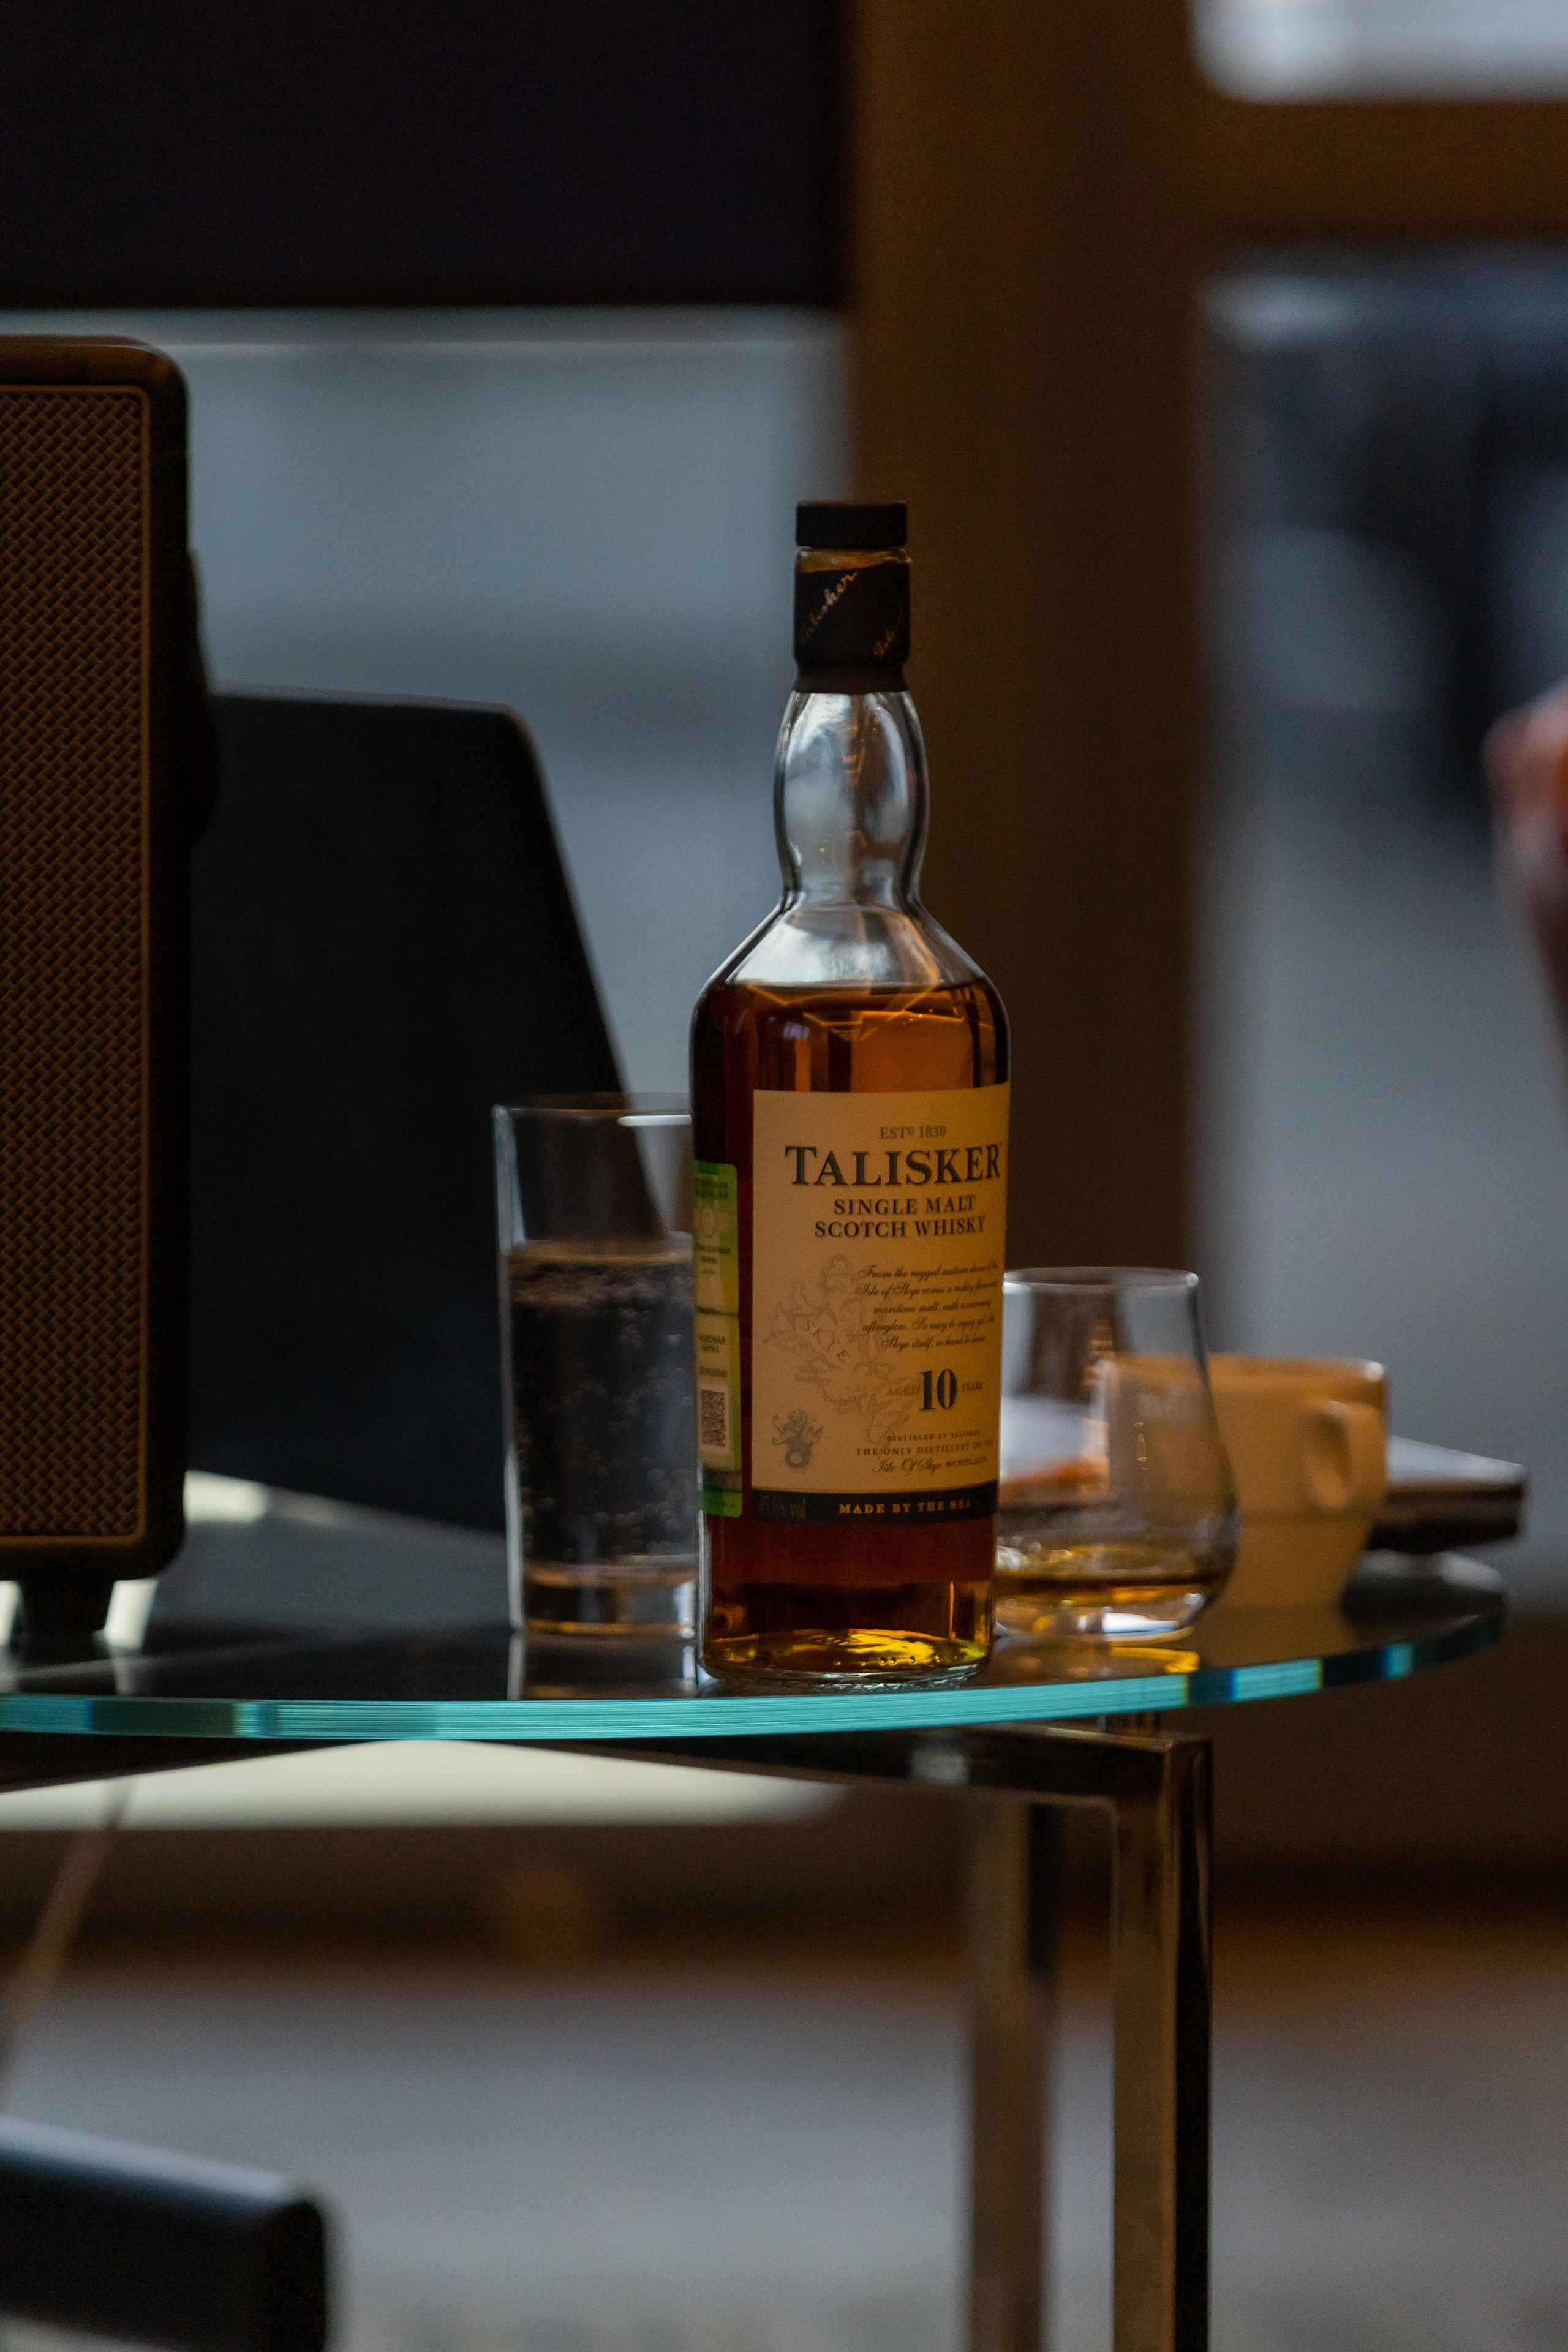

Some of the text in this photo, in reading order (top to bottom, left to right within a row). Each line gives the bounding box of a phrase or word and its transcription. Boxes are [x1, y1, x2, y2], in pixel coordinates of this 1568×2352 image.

[919, 1125, 947, 1139] 1830
[785, 1143, 1002, 1186] TALISKER
[834, 1194, 976, 1216] SINGLE MALT
[815, 1215, 987, 1238] SCOTCH WHISKY
[858, 1264, 891, 1279] From
[894, 1265, 908, 1278] the
[910, 1264, 942, 1283] rugged
[855, 1282, 878, 1297] Isle
[881, 1283, 894, 1300] of
[892, 1281, 920, 1300] Skye
[873, 1303, 916, 1314] maritime
[919, 1299, 941, 1313] malt,
[862, 1318, 910, 1336] afterglow.
[912, 1316, 929, 1330] So
[949, 1318, 957, 1328] to
[881, 1335, 910, 1354] Skye
[886, 1368, 983, 1411] AGED 10 YEARS
[886, 1434, 935, 1442] DISTILLED
[883, 1447, 911, 1455] ONLY
[917, 1444, 969, 1454] DISTILLERY
[872, 1458, 895, 1472] Isle
[918, 1457, 942, 1476] Skye
[946, 1455, 988, 1468] SCOTLAND
[839, 1498, 971, 1514] MADE BY THE SEA
